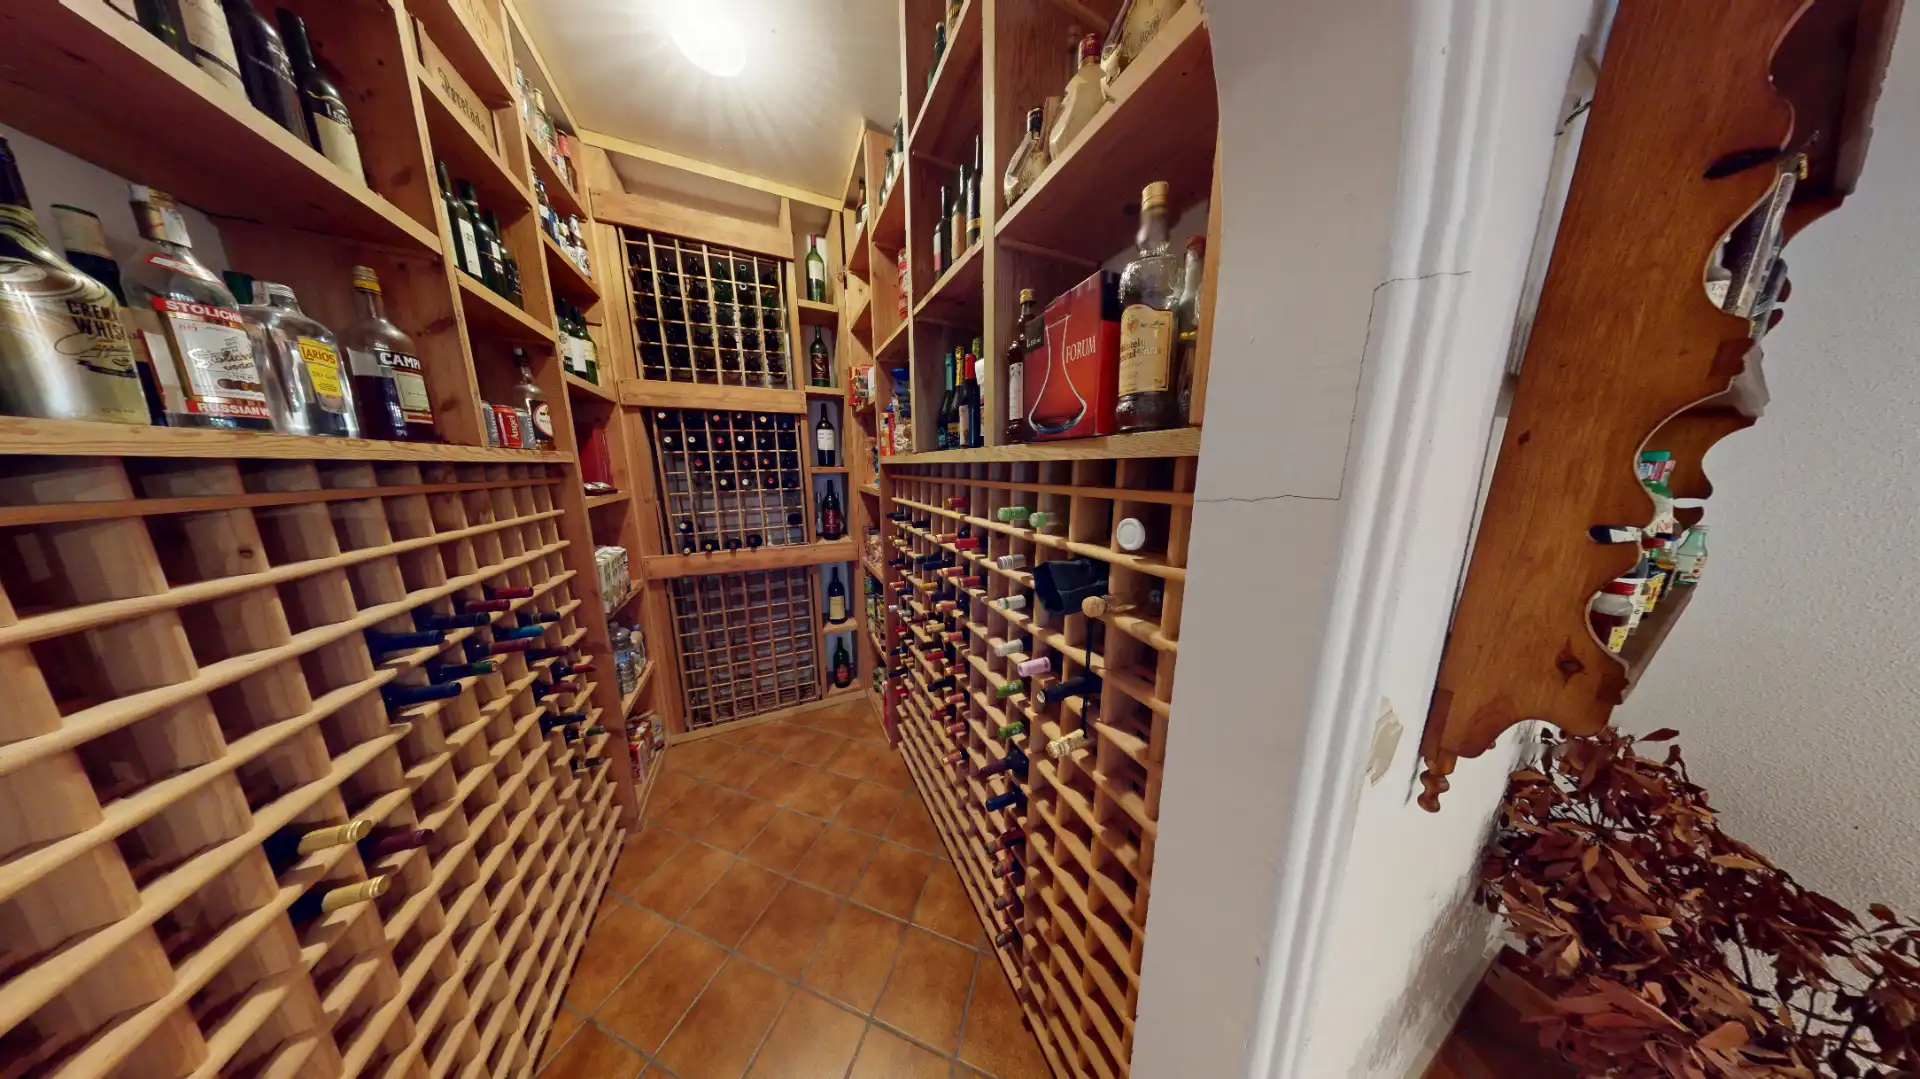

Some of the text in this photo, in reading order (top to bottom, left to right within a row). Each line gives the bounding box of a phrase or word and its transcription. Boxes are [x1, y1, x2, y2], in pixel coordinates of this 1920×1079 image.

[300, 346, 336, 364] LARIOS
[1066, 335, 1097, 364] FORUM
[196, 402, 259, 416] RUSSIAN
